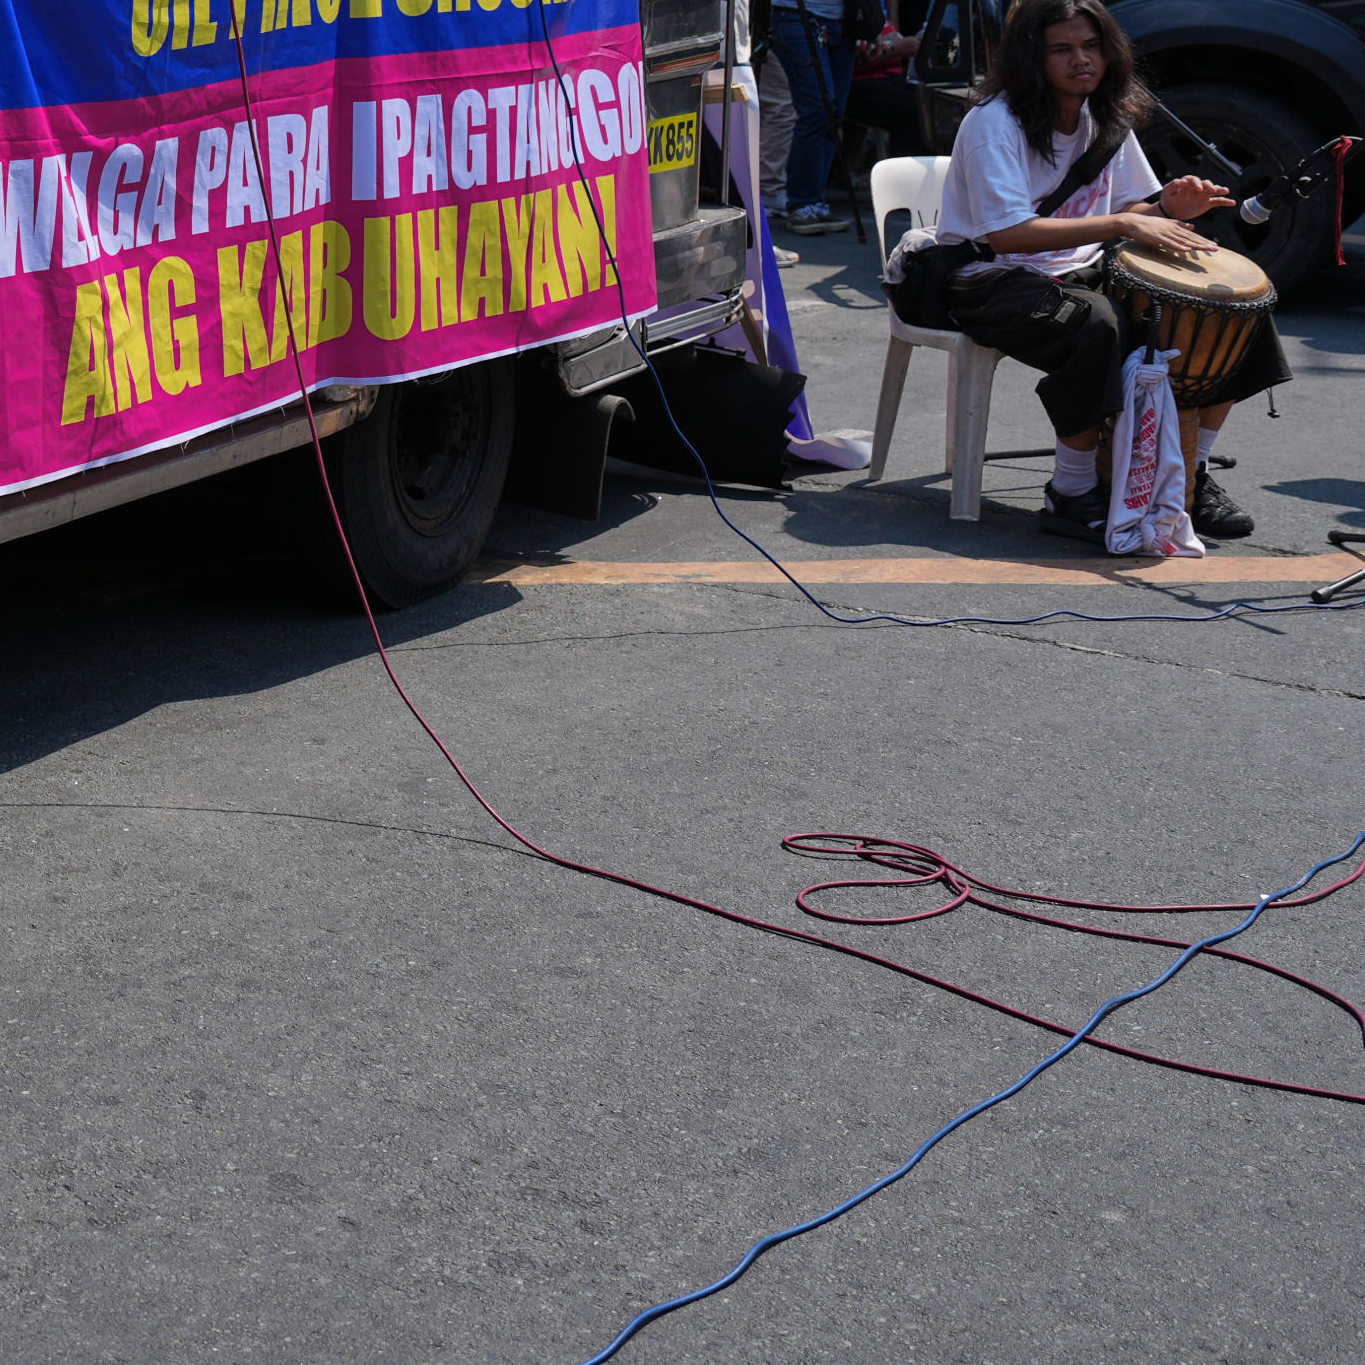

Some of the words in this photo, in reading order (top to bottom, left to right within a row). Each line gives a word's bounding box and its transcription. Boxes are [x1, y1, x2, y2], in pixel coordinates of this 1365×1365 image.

[191, 104, 332, 235] PARA
[60, 255, 202, 426] ANG
[216, 175, 620, 379] KABUHAYAN!
